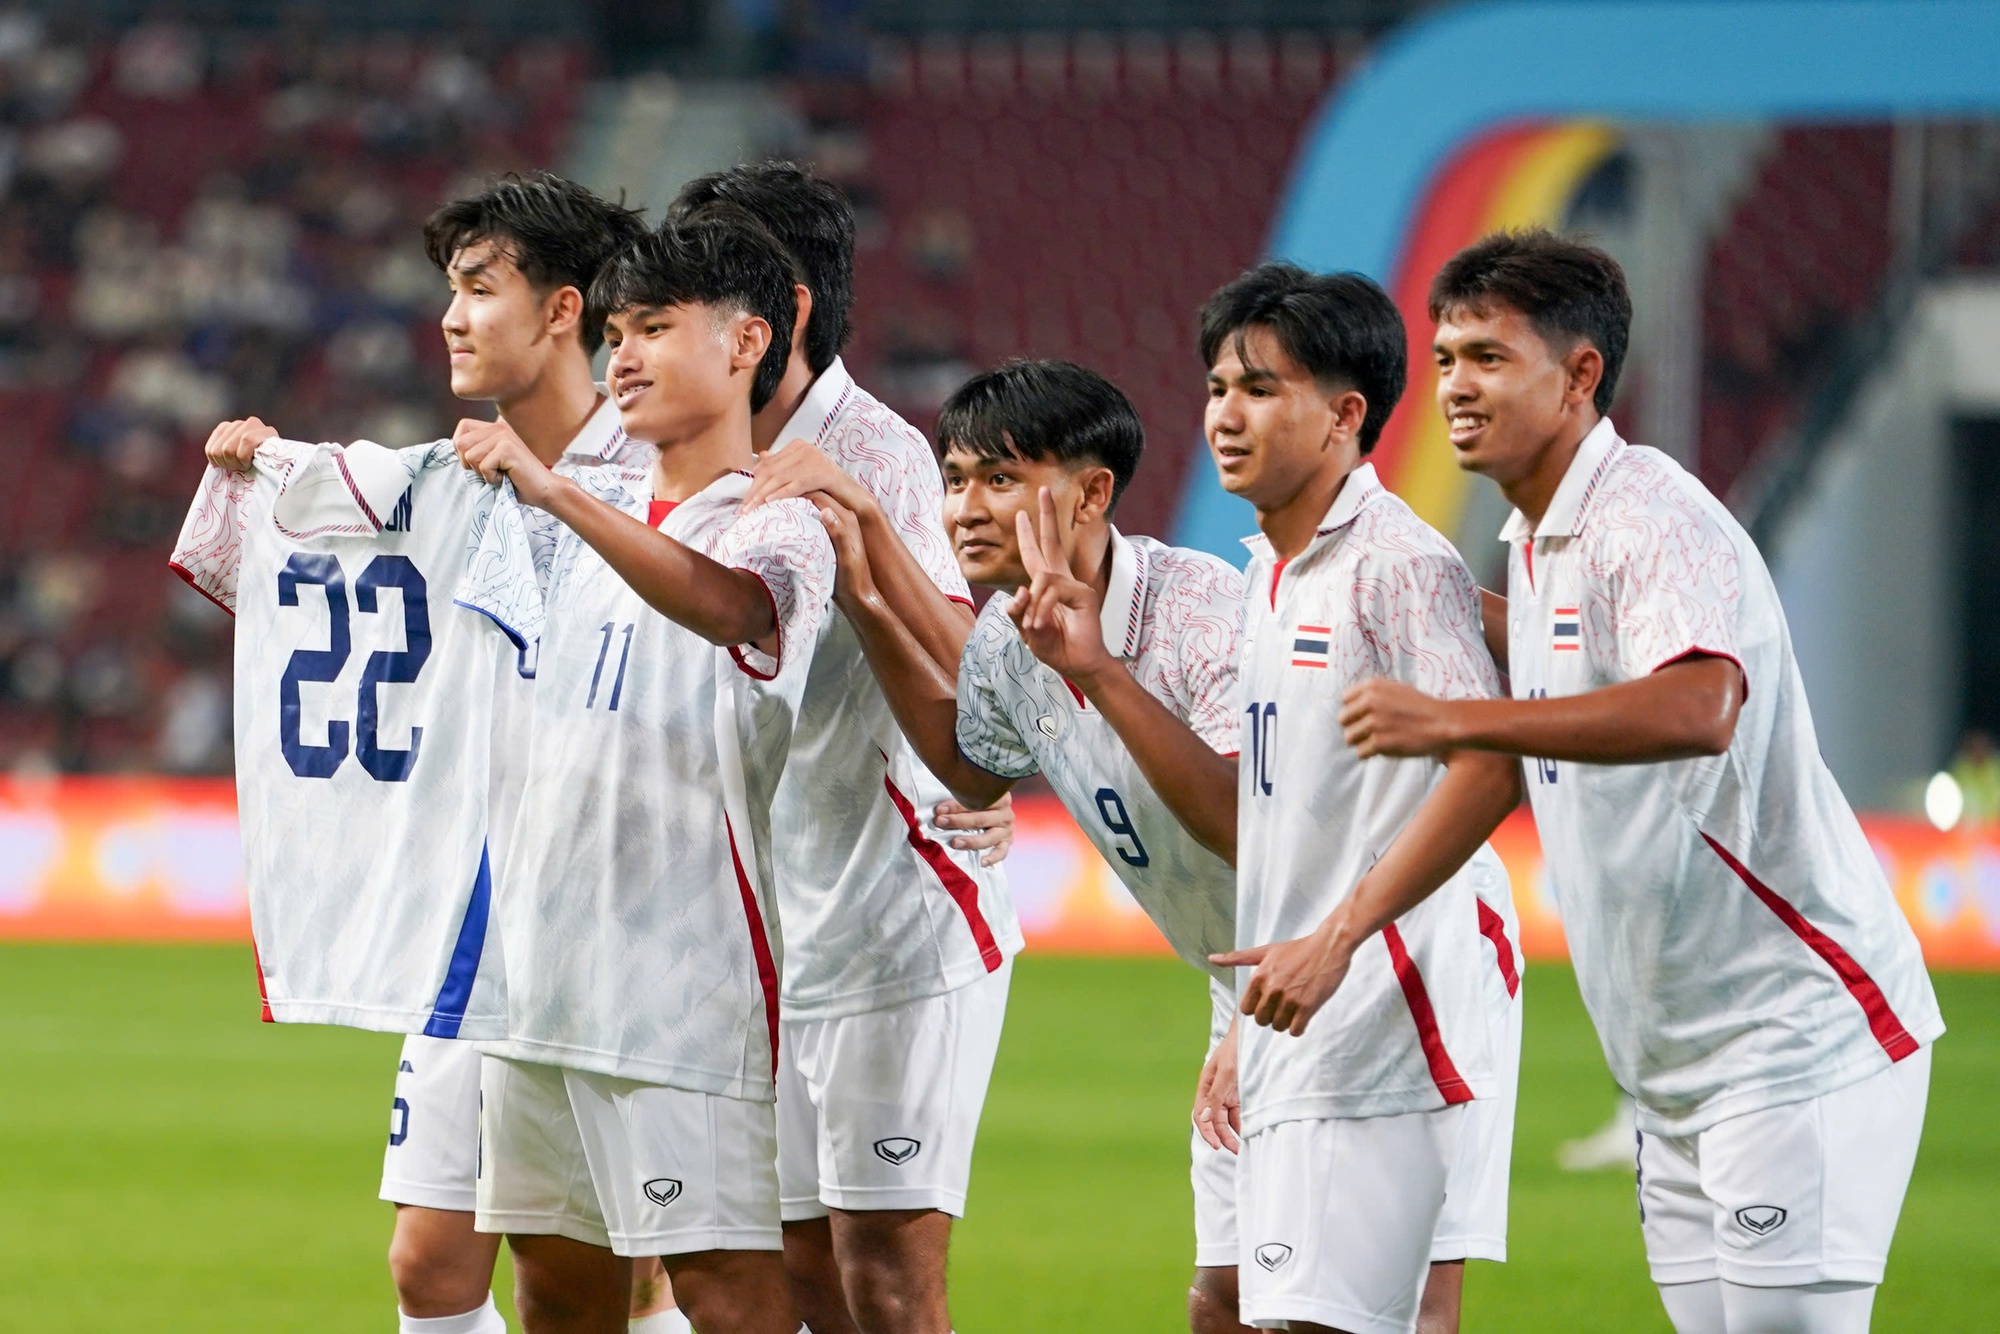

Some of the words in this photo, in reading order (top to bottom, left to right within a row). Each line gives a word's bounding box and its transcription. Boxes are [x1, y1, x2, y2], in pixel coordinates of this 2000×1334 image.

[278, 552, 432, 782] 22
[586, 622, 635, 711] 11
[1246, 702, 1278, 797] 10
[1095, 788, 1149, 867] 9
